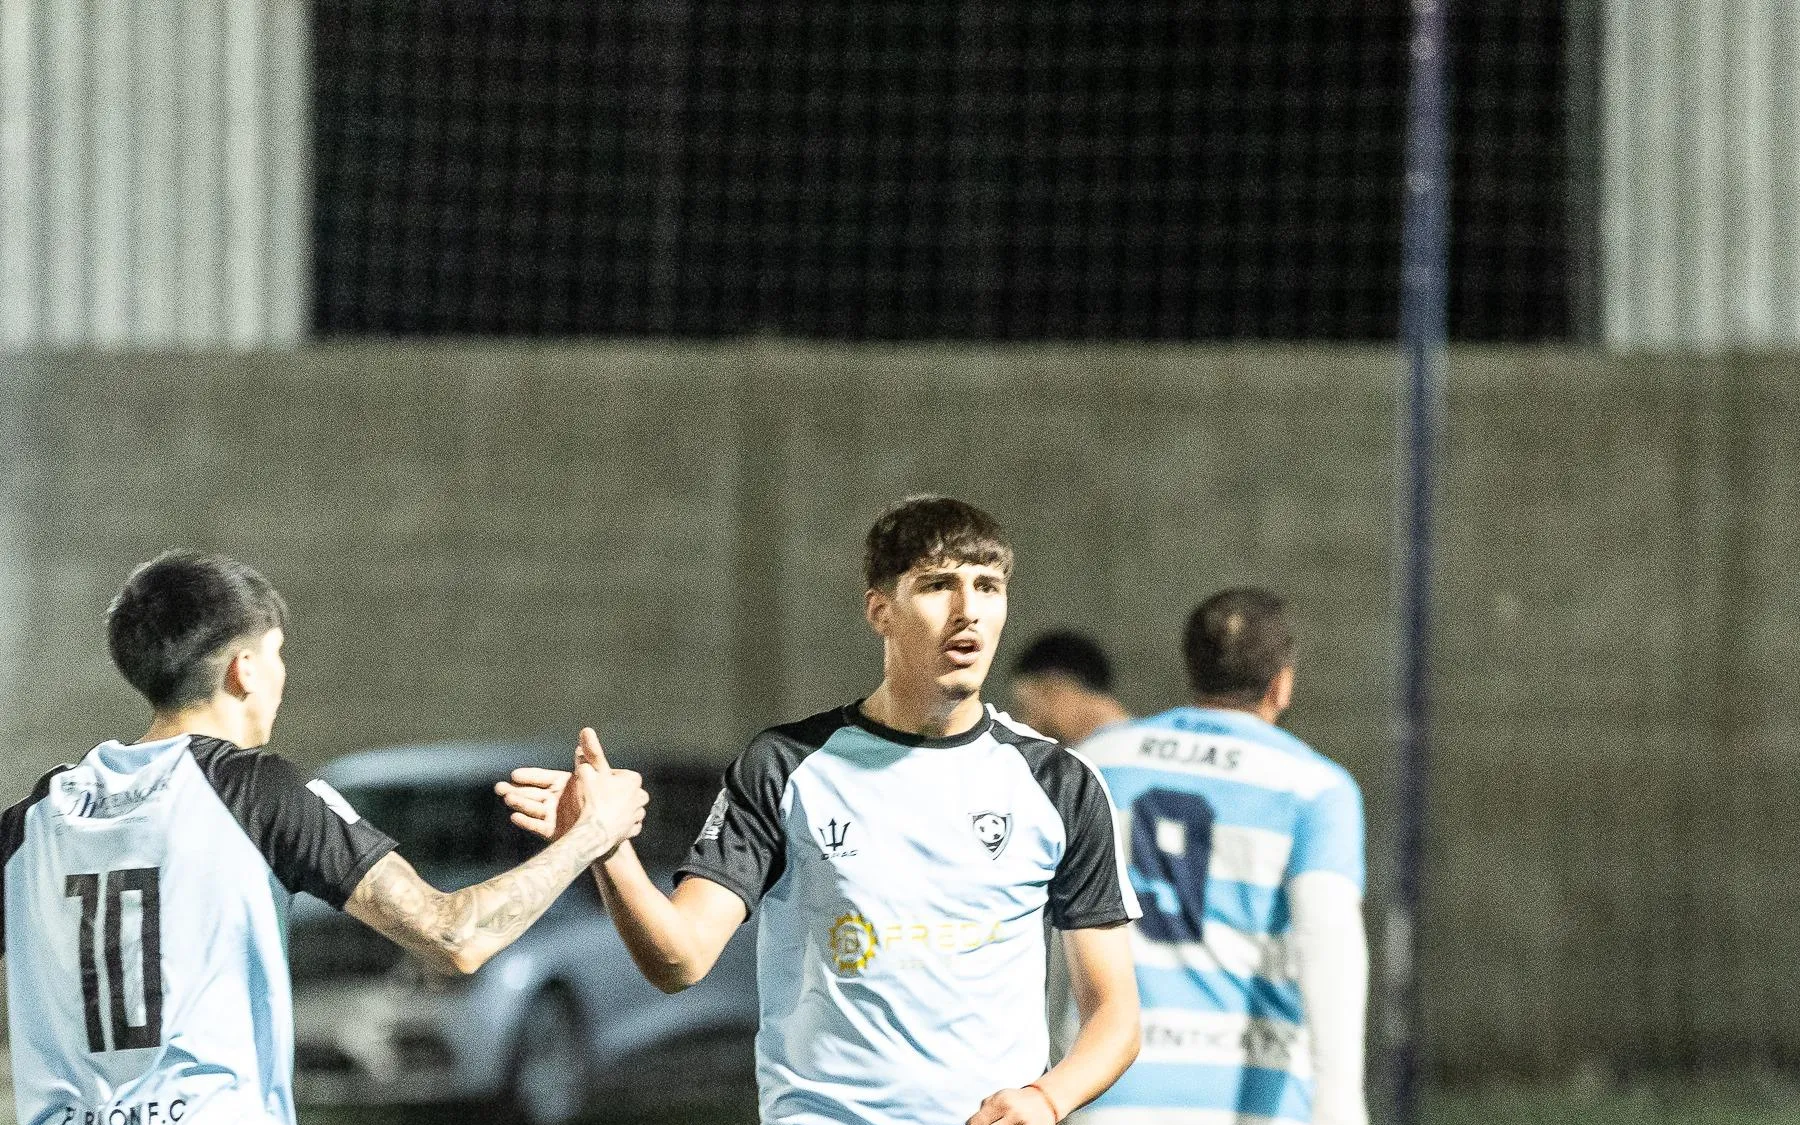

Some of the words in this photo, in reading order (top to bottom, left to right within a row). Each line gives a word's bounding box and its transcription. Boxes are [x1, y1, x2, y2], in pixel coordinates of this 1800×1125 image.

[1138, 736, 1242, 770] ROJAS
[1131, 786, 1214, 944] 9
[66, 867, 162, 1053] 10
